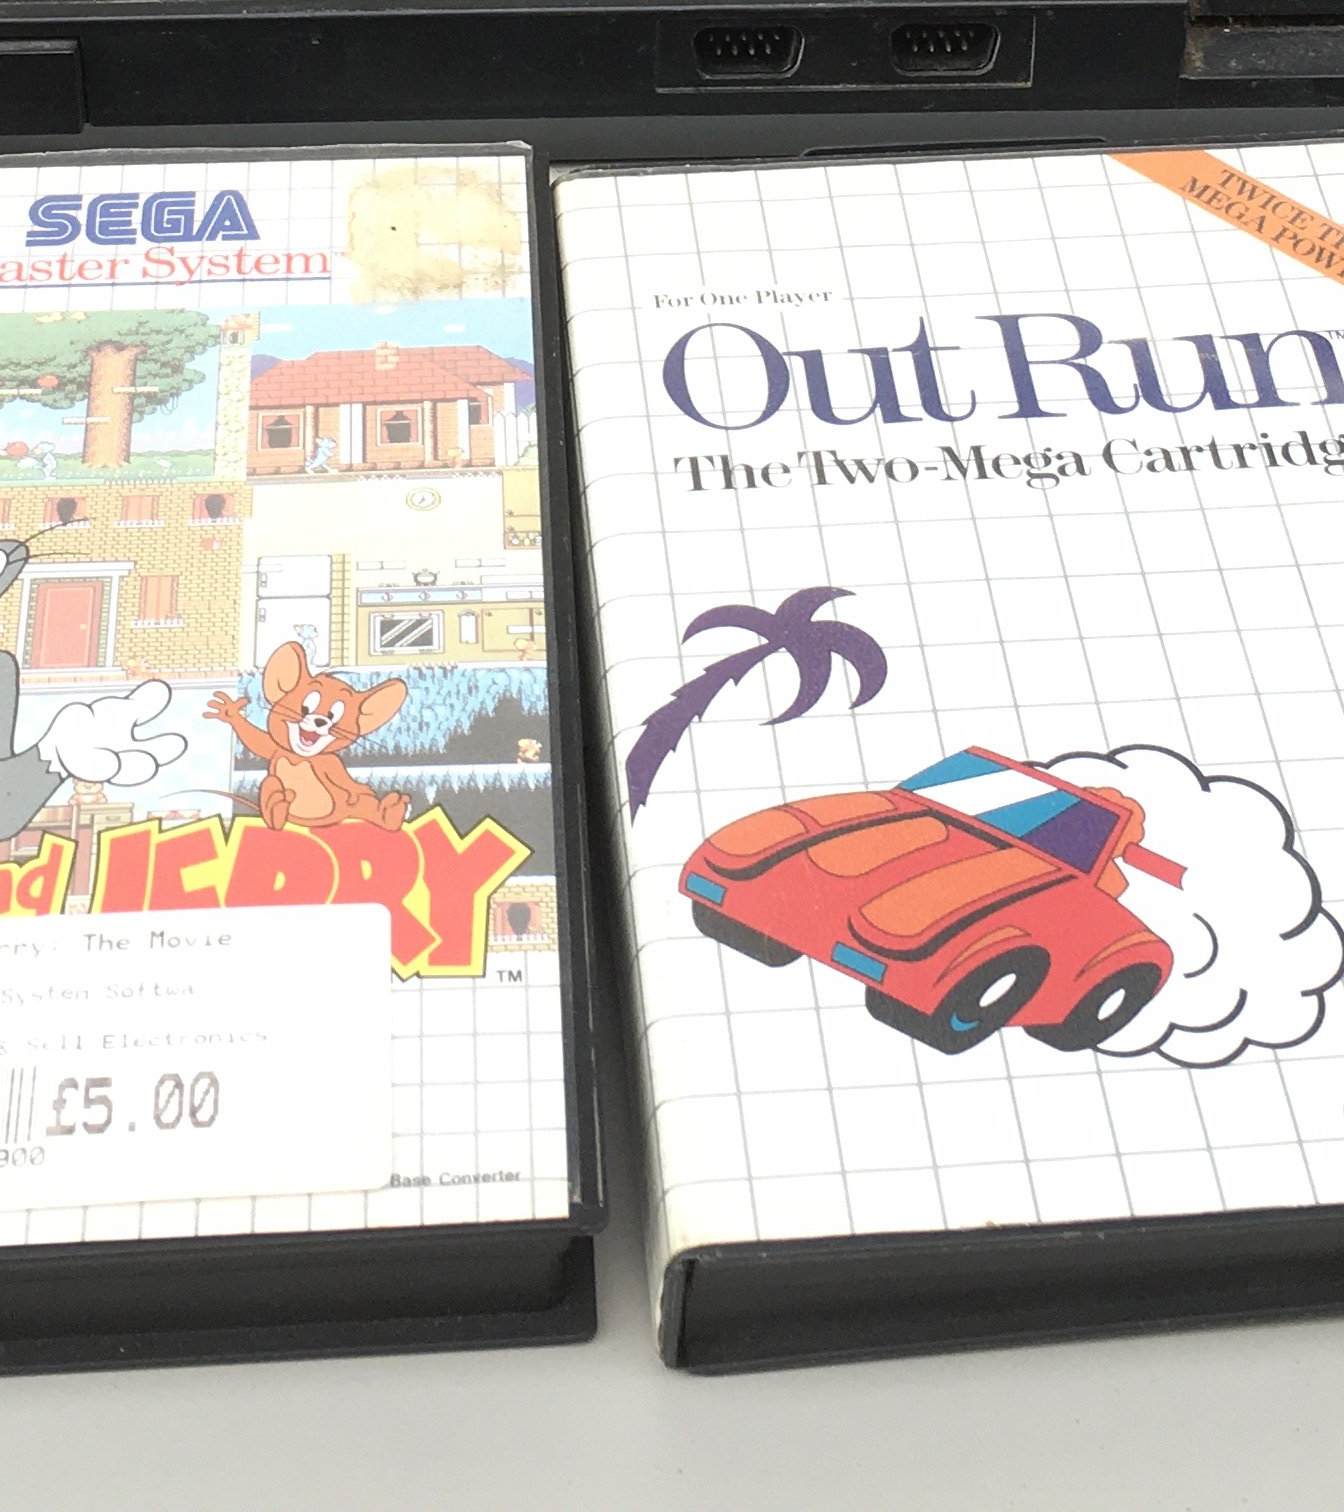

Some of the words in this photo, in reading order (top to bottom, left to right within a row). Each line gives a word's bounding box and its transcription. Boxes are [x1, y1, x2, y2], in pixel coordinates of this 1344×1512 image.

[24, 190, 260, 247] SEGA
[1178, 176, 1272, 239] MEGA
[1215, 169, 1314, 235] TWICE
[141, 245, 332, 287] System
[653, 293, 692, 311] For
[698, 290, 748, 308] One
[755, 288, 833, 309] Player
[661, 316, 978, 432] Out
[673, 453, 792, 493] The
[797, 443, 1091, 491] Two-Mega
[83, 932, 131, 951] The
[150, 930, 232, 949] Movie
[46, 1071, 220, 1136] £5.00
[390, 1173, 432, 1188] Base
[439, 1170, 521, 1186] Converter
